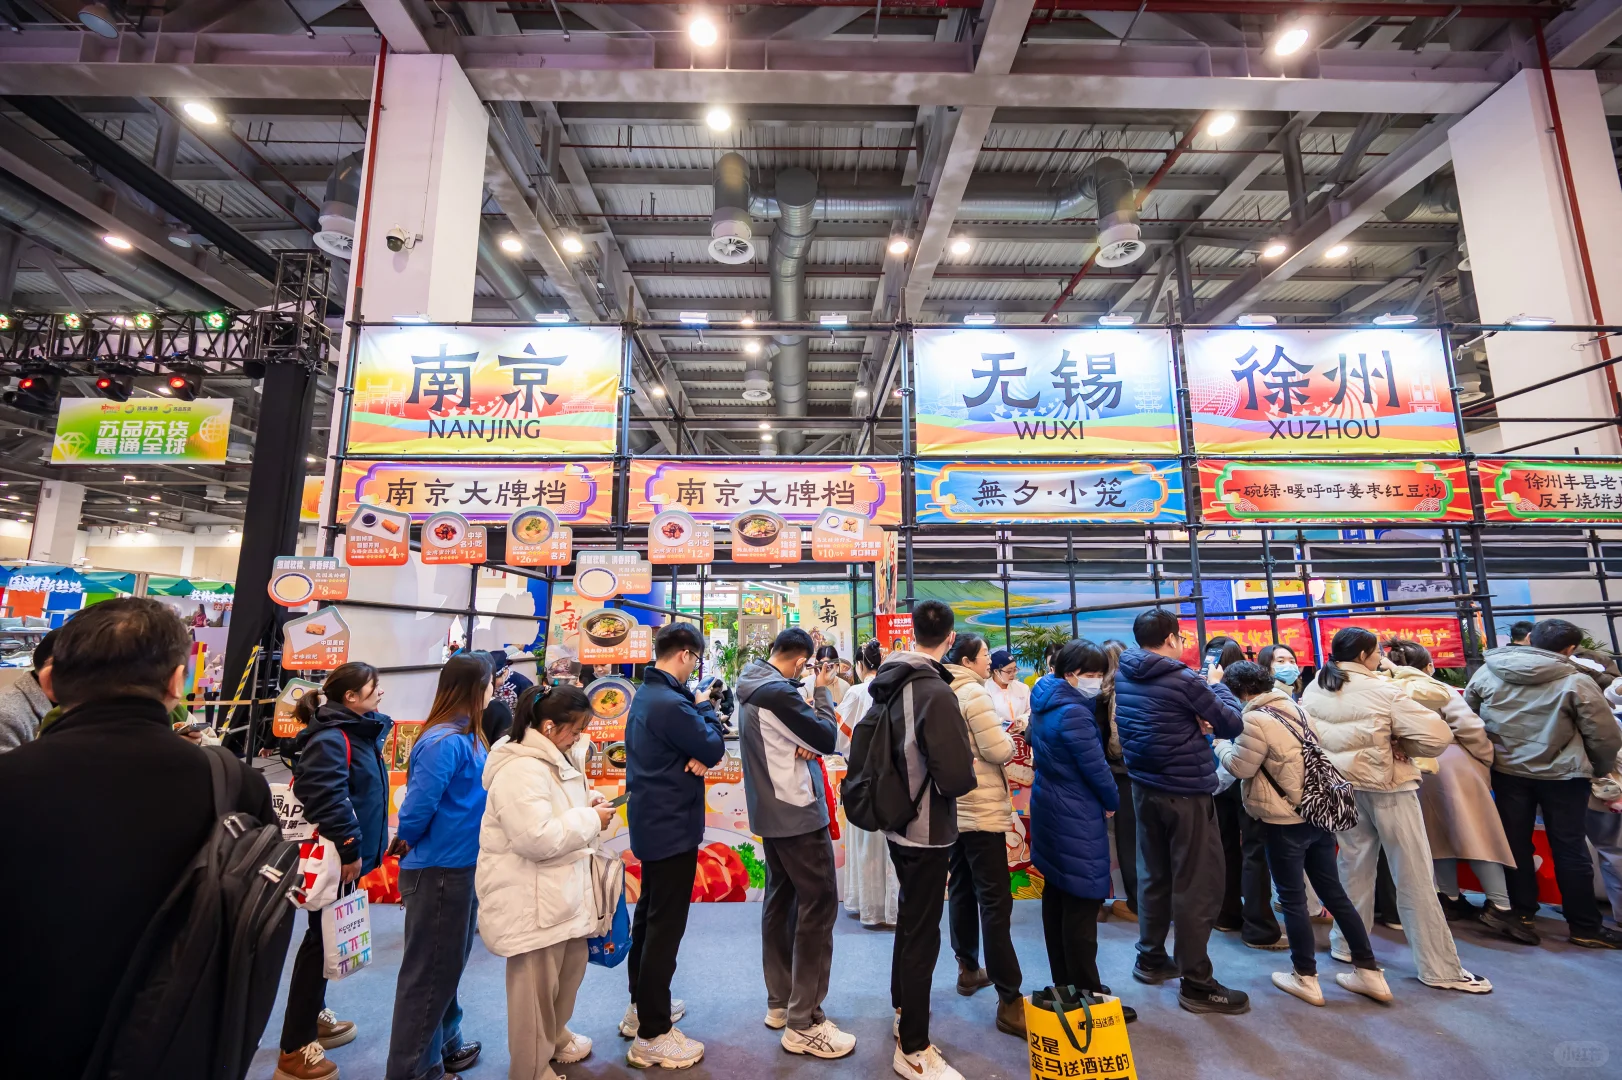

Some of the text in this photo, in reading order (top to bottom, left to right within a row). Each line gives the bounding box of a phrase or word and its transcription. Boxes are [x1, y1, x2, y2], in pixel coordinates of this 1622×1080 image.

[405, 342, 569, 413] 南京
[963, 349, 1123, 410] 无锡
[1231, 345, 1400, 414] 徐州
[98, 420, 190, 437] 苏品苏货
[428, 419, 541, 442] NANJING
[1013, 420, 1085, 440] WUXI
[1268, 419, 1380, 440] XUZHOU
[95, 438, 187, 455] 惠通全球
[386, 478, 567, 507] 南京大牌档
[676, 477, 855, 507] 南京大牌档
[1524, 473, 1622, 490] 徐州丰县老
[8, 574, 85, 593] 国潮新丝路
[338, 917, 365, 933] KCOFFEE
[1208, 994, 1229, 1004] HOKA
[1030, 1030, 1060, 1056] 这是
[1030, 1053, 1130, 1077] 歪马送酒送的
